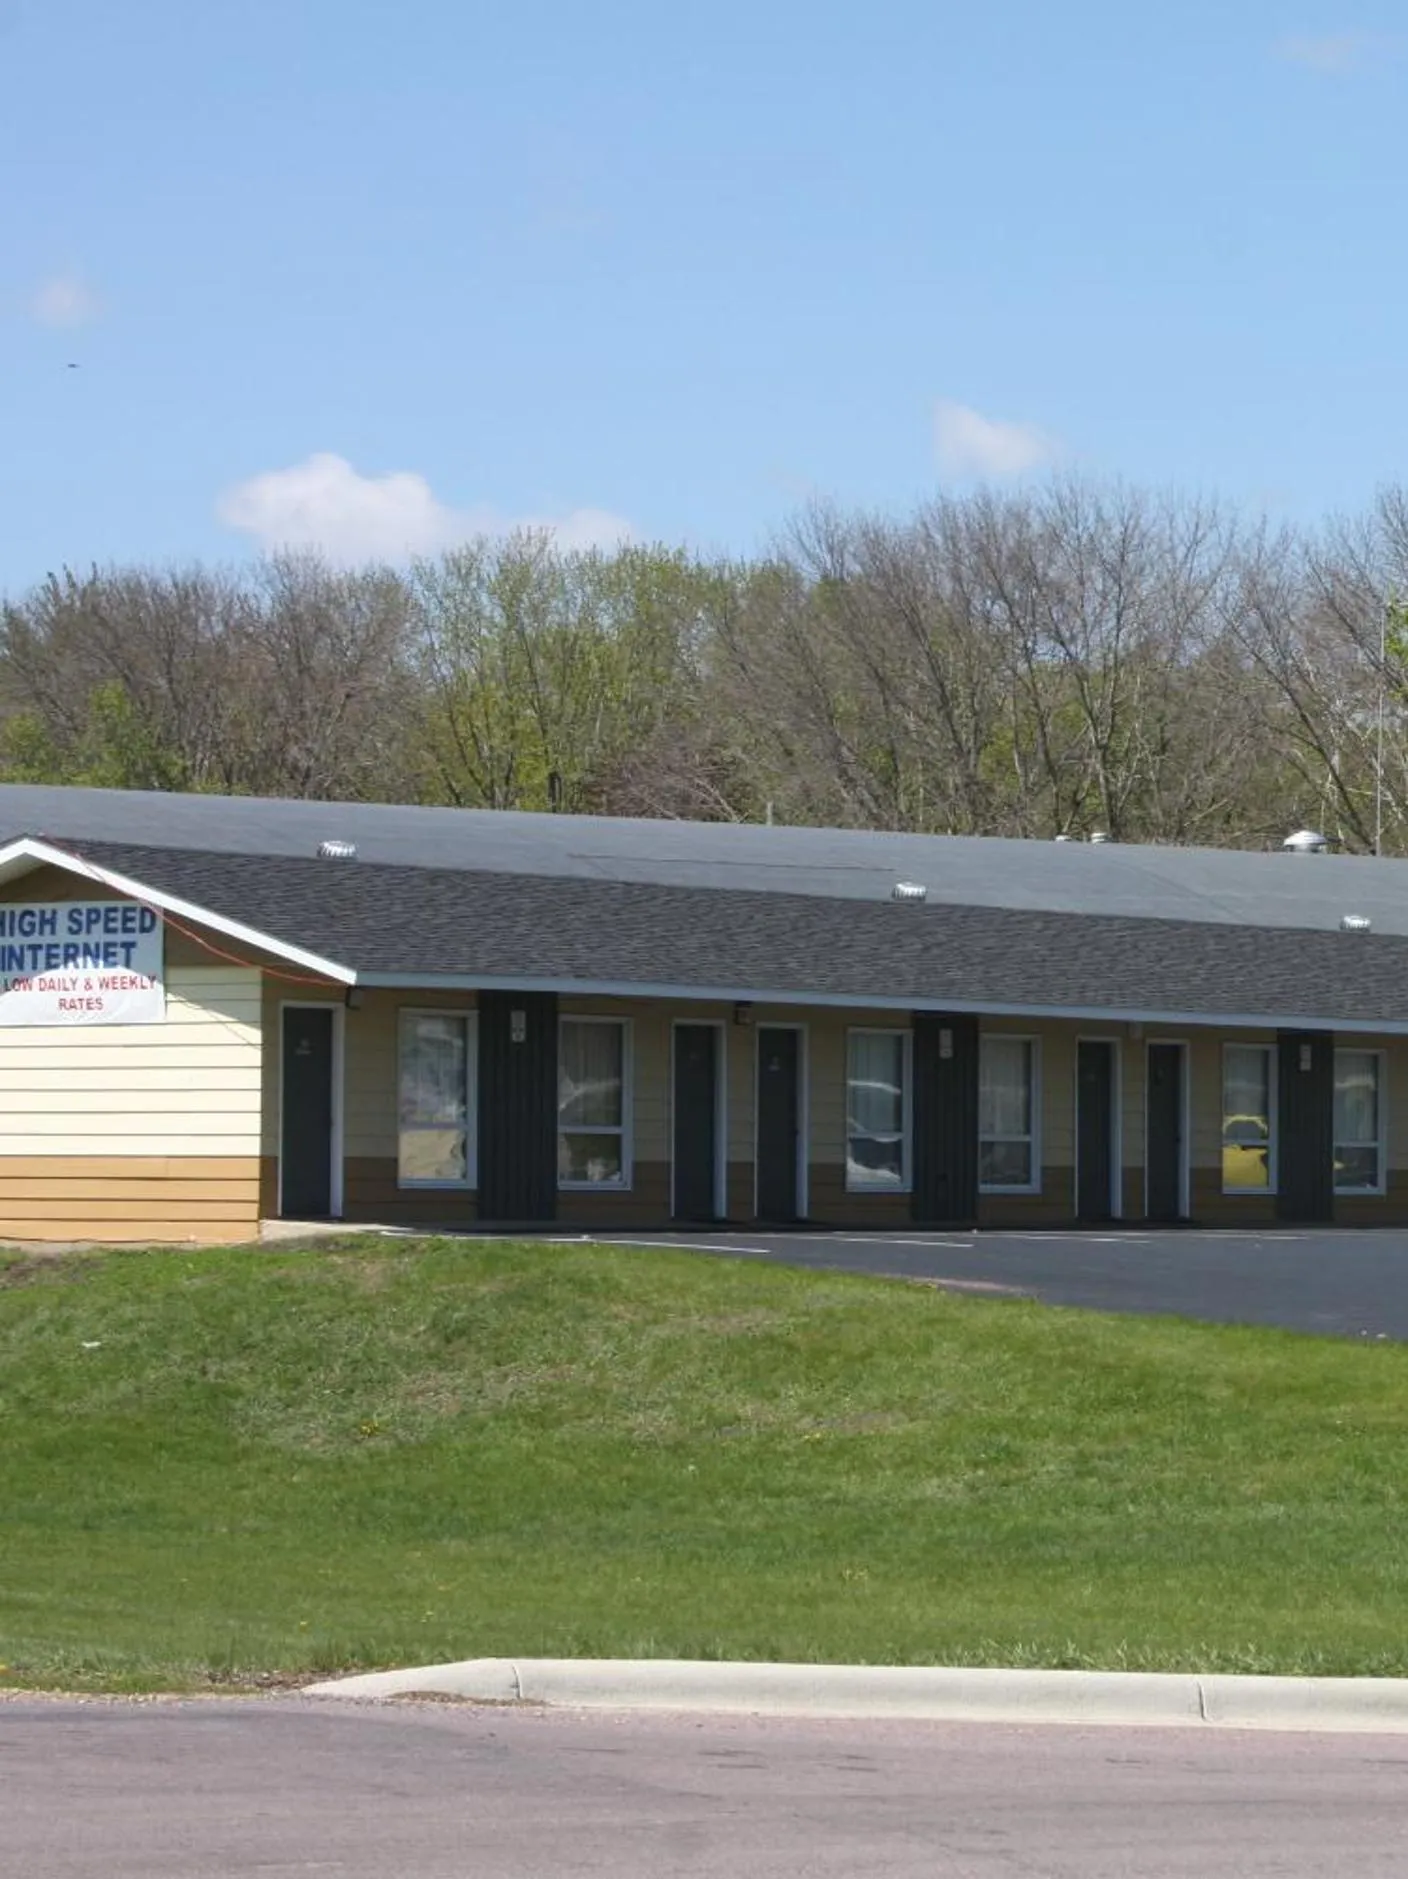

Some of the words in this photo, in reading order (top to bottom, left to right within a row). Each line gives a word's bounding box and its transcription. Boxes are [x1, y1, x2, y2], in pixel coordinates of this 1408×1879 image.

[67, 906, 157, 935] SPEED
[1, 942, 137, 972] INTERNET
[4, 977, 33, 992] LOW
[38, 976, 79, 992] DAILY
[83, 977, 95, 991] &
[98, 975, 157, 990] WEEKLY
[58, 998, 104, 1011] RATES
